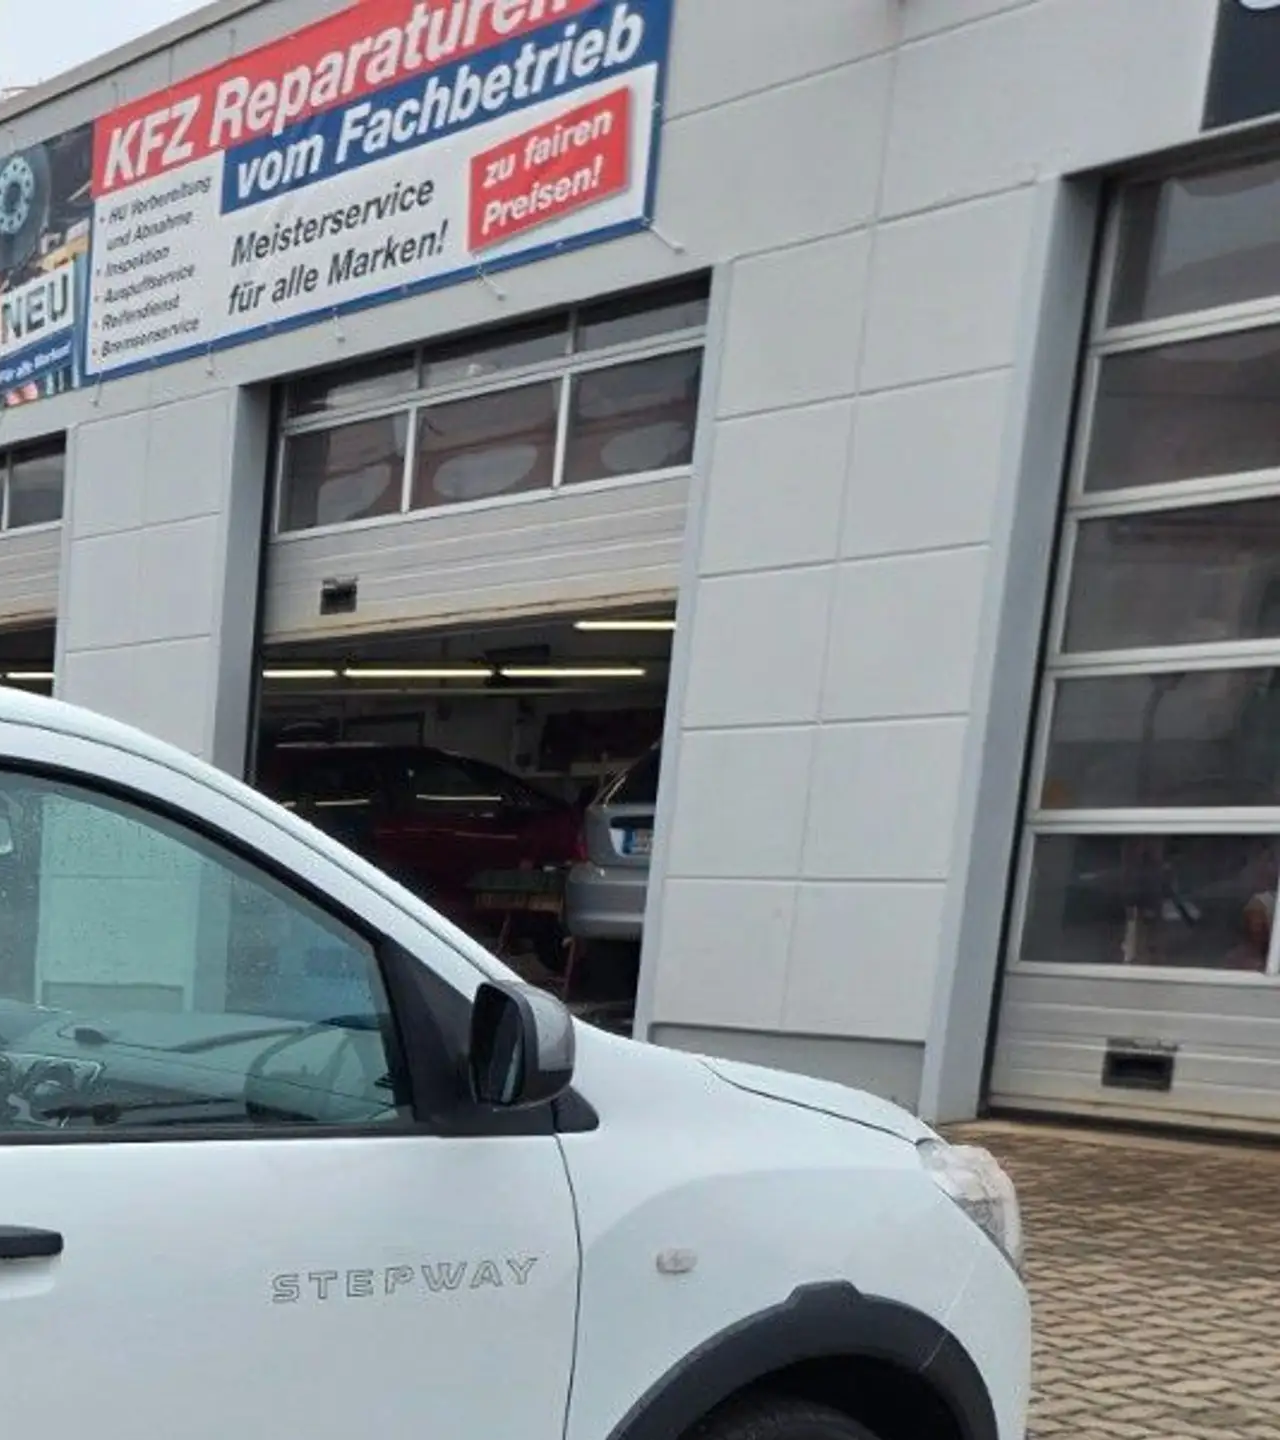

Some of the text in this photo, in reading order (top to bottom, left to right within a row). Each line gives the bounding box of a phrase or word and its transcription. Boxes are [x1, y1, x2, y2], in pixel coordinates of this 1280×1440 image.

[238, 3, 643, 198] vom Fachbetrieb
[102, 95, 201, 188] KFZ
[482, 111, 613, 188] zu fairen
[107, 211, 193, 250] und Abnahme
[108, 176, 213, 224] HU Vorbereitung
[230, 179, 435, 267] Meisterservice
[482, 154, 604, 236] Preisen!
[105, 247, 170, 276] Inspektion
[228, 219, 449, 315] für alle Marken!
[0, 274, 68, 345] NEU
[101, 318, 199, 357] Bremsenservice
[102, 295, 180, 330] Reifendienst
[272, 1257, 539, 1303] STEPWAY
